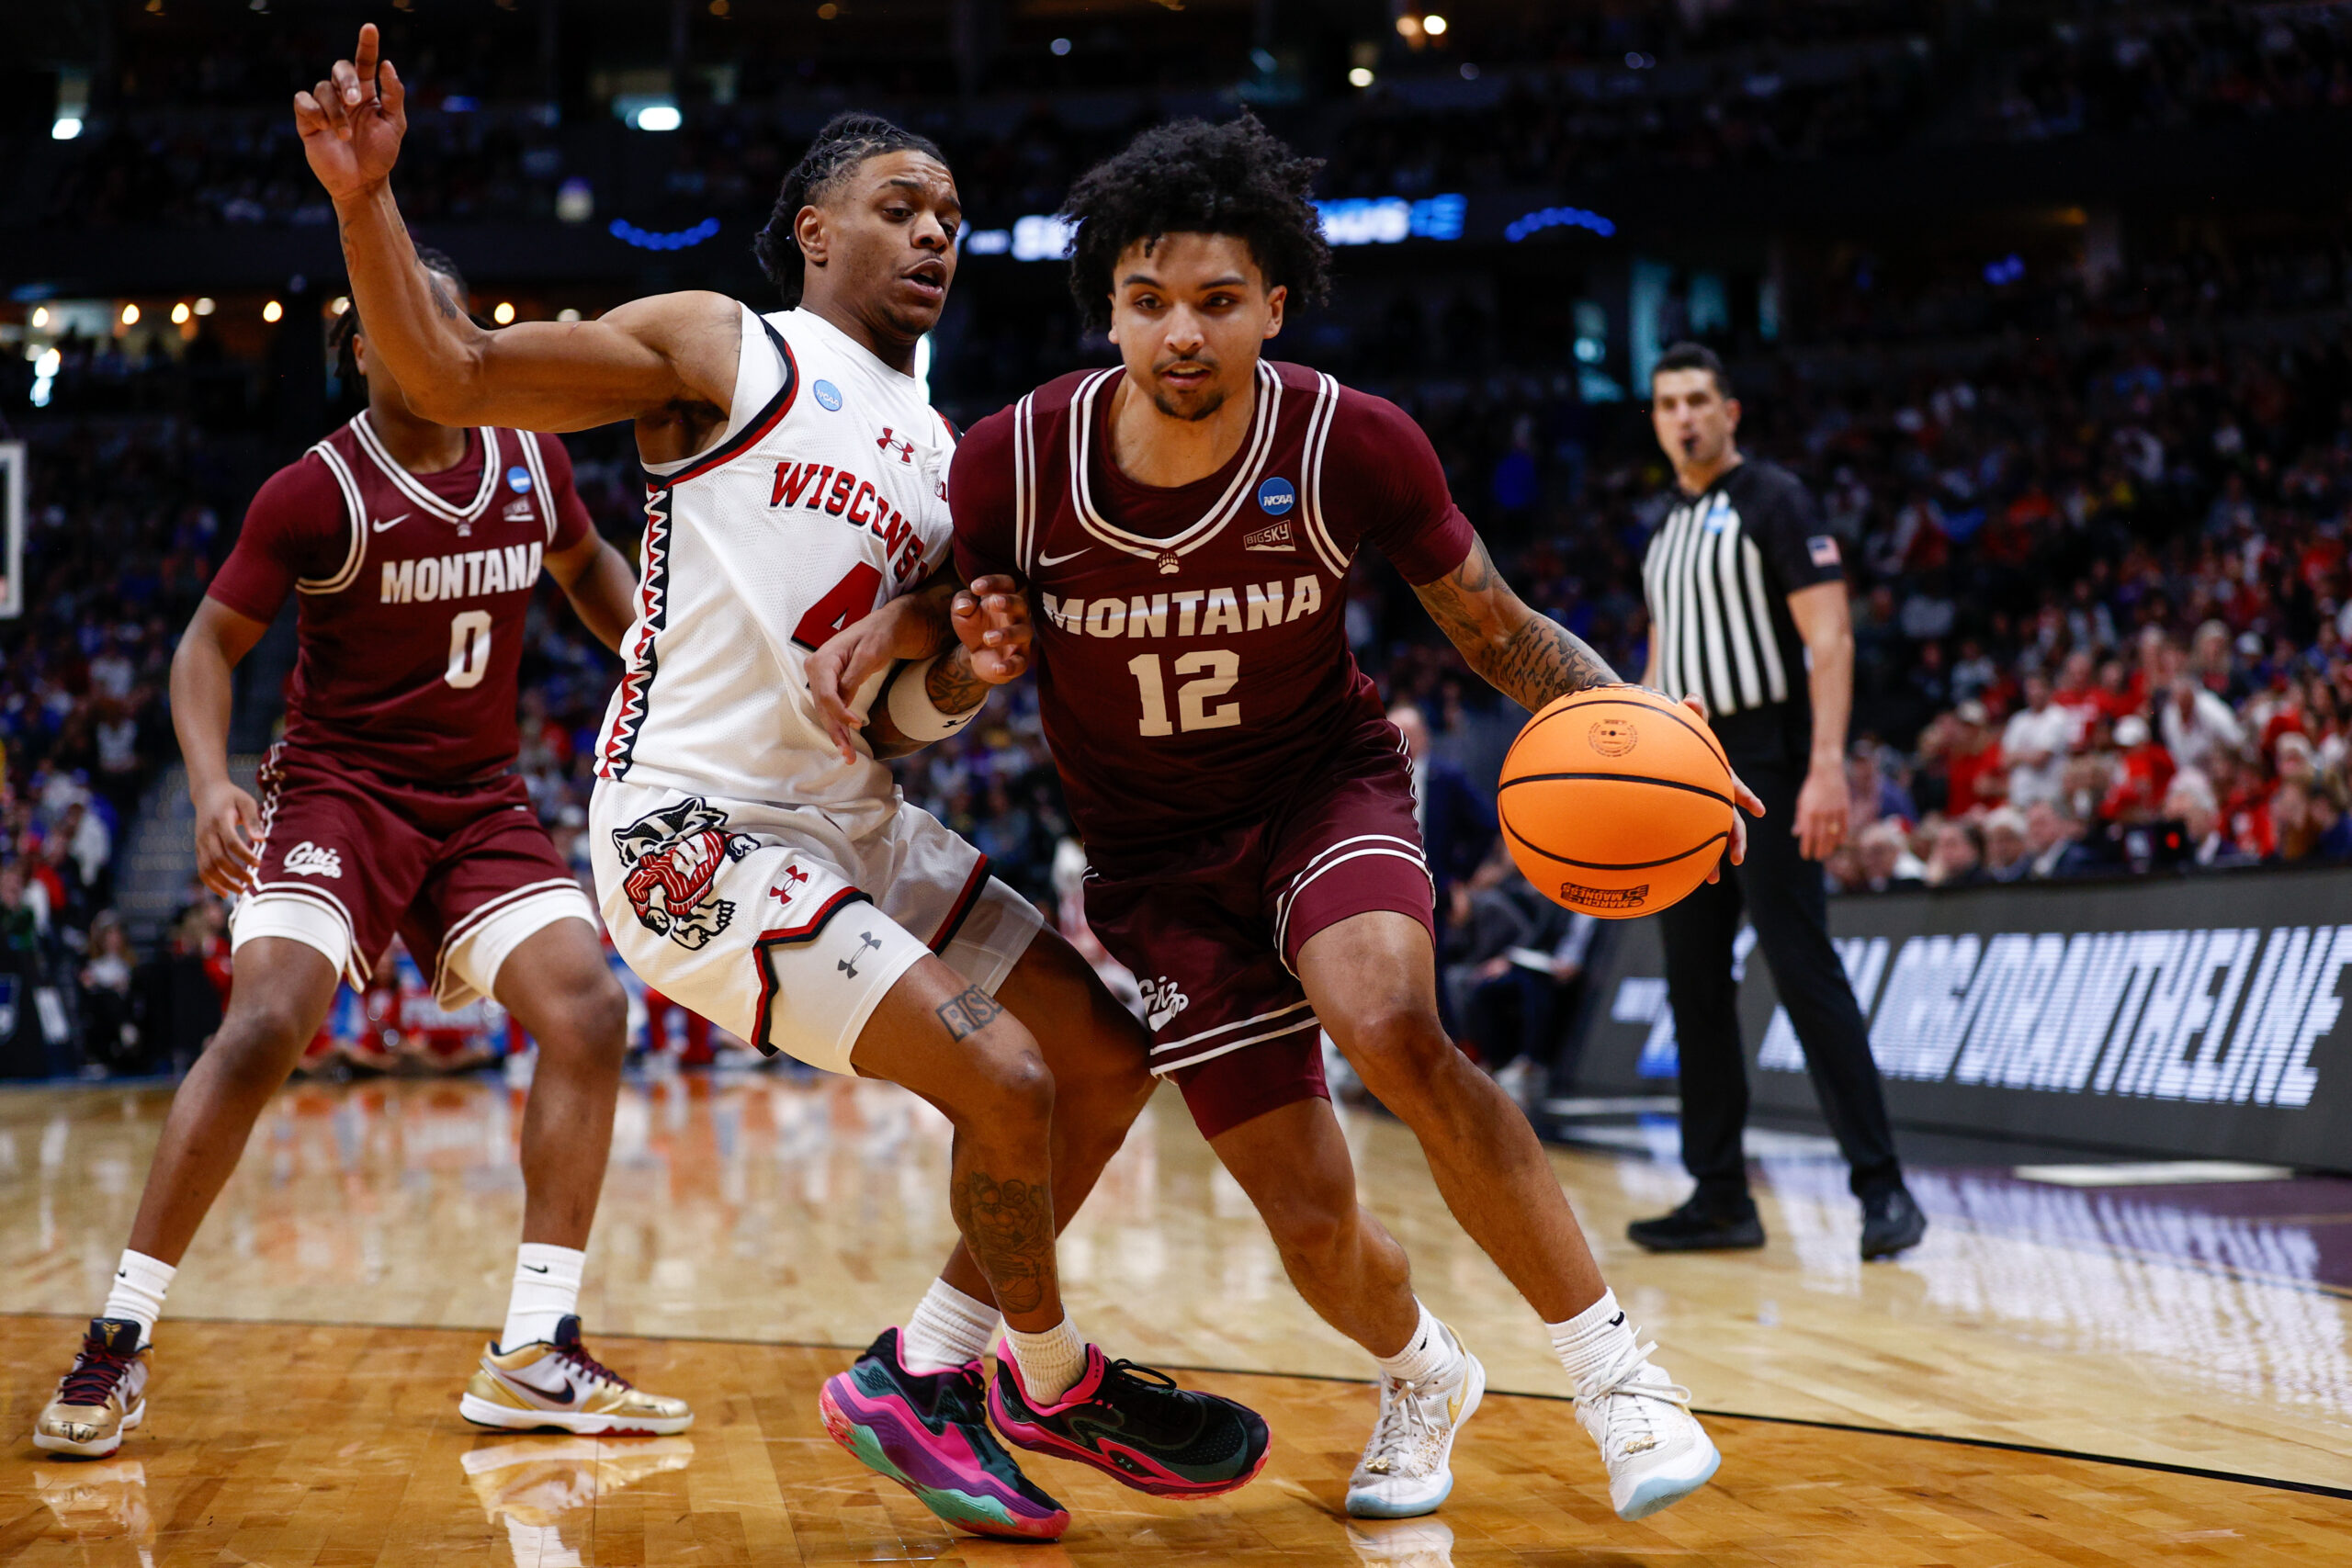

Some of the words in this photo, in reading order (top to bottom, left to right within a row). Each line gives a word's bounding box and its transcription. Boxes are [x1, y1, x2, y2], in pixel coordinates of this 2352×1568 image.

[817, 389, 841, 407] NCAA
[1263, 494, 1294, 506] NCAA
[380, 540, 543, 604] MONTANA
[789, 560, 883, 652] 4
[1042, 574, 1322, 638] MONTANA
[444, 609, 492, 689] 0
[1127, 649, 1241, 737] 12
[283, 840, 342, 879] Griz
[1562, 883, 1624, 901] MADNESS
[1582, 897, 1631, 908] MARCH
